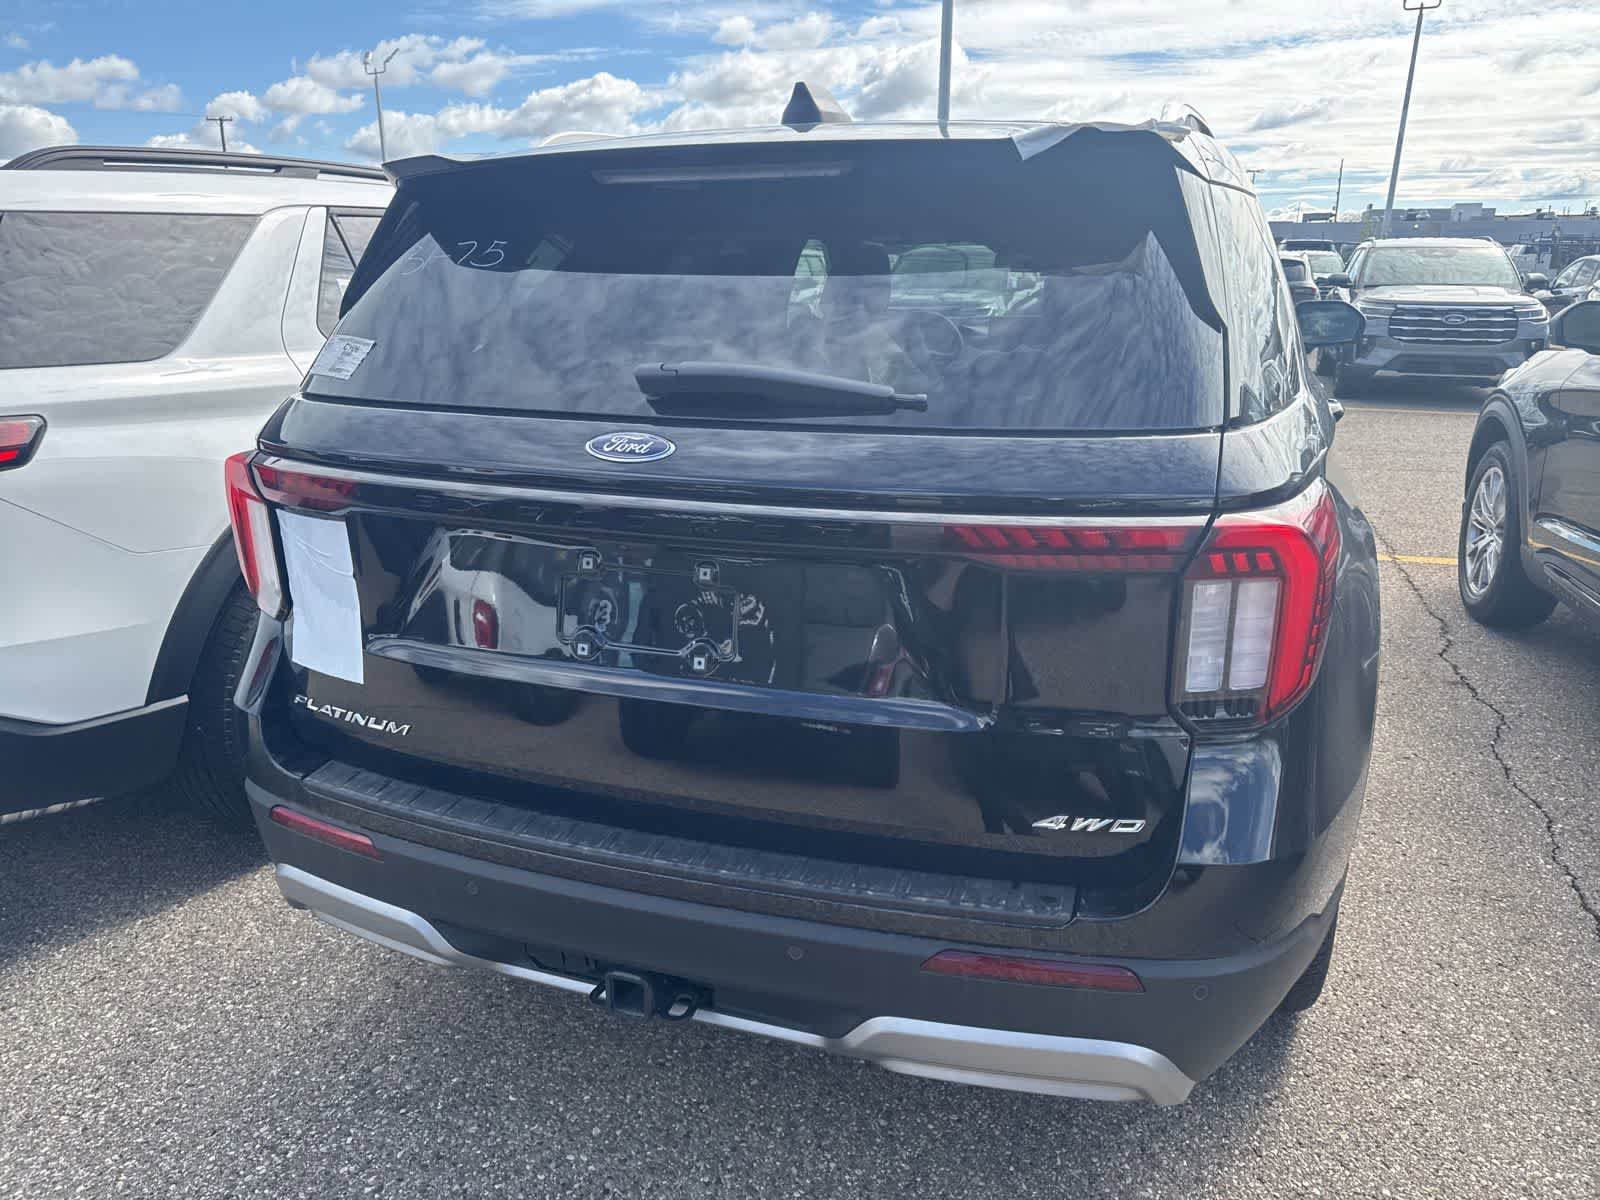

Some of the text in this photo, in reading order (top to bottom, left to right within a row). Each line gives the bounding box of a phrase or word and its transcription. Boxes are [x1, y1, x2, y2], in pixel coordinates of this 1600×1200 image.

[602, 434, 655, 454] Ford
[293, 693, 412, 736] PLATINUM
[1031, 815, 1147, 833] 4WD
